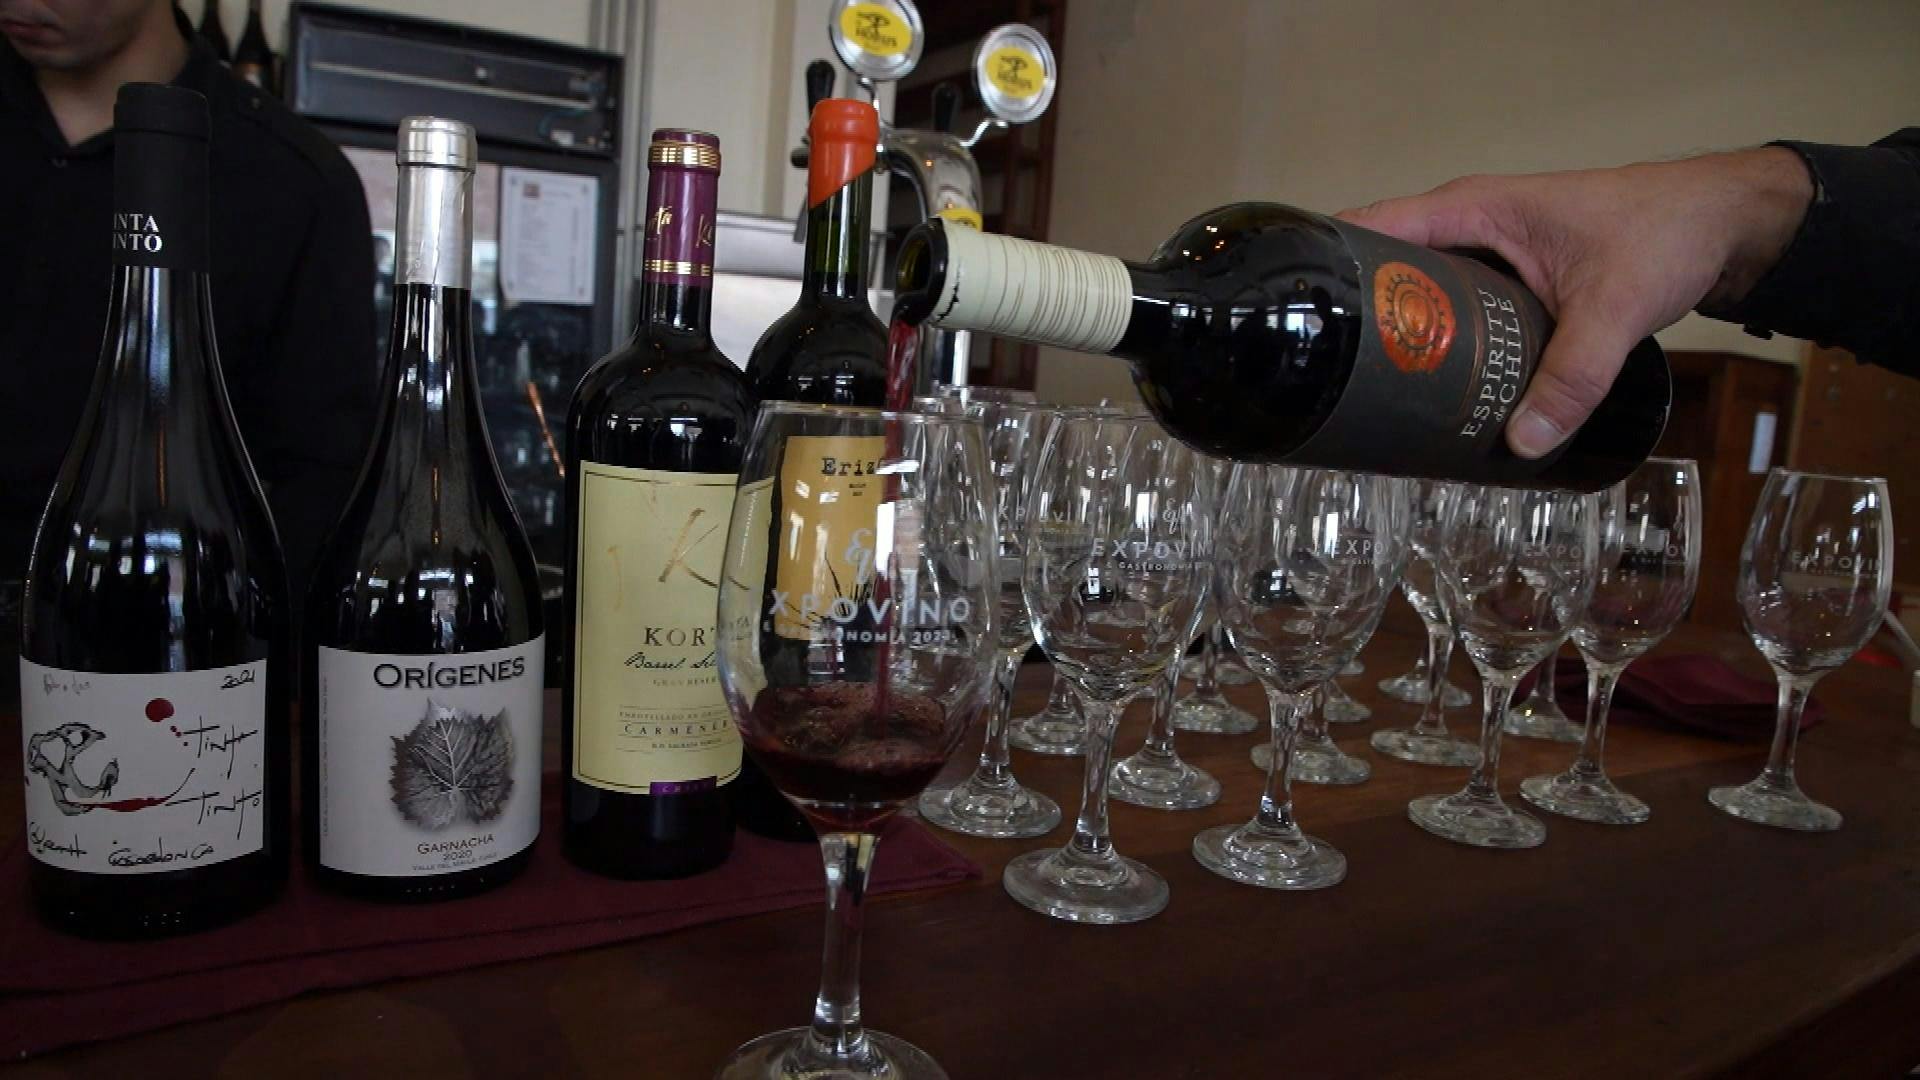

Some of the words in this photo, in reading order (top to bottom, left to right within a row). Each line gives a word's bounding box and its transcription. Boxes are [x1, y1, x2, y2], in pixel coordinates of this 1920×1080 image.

[1497, 297, 1522, 404] CHILE
[769, 589, 970, 624] XPOVINO
[373, 656, 526, 689] ORÍGENES
[417, 833, 495, 855] GARNACHA
